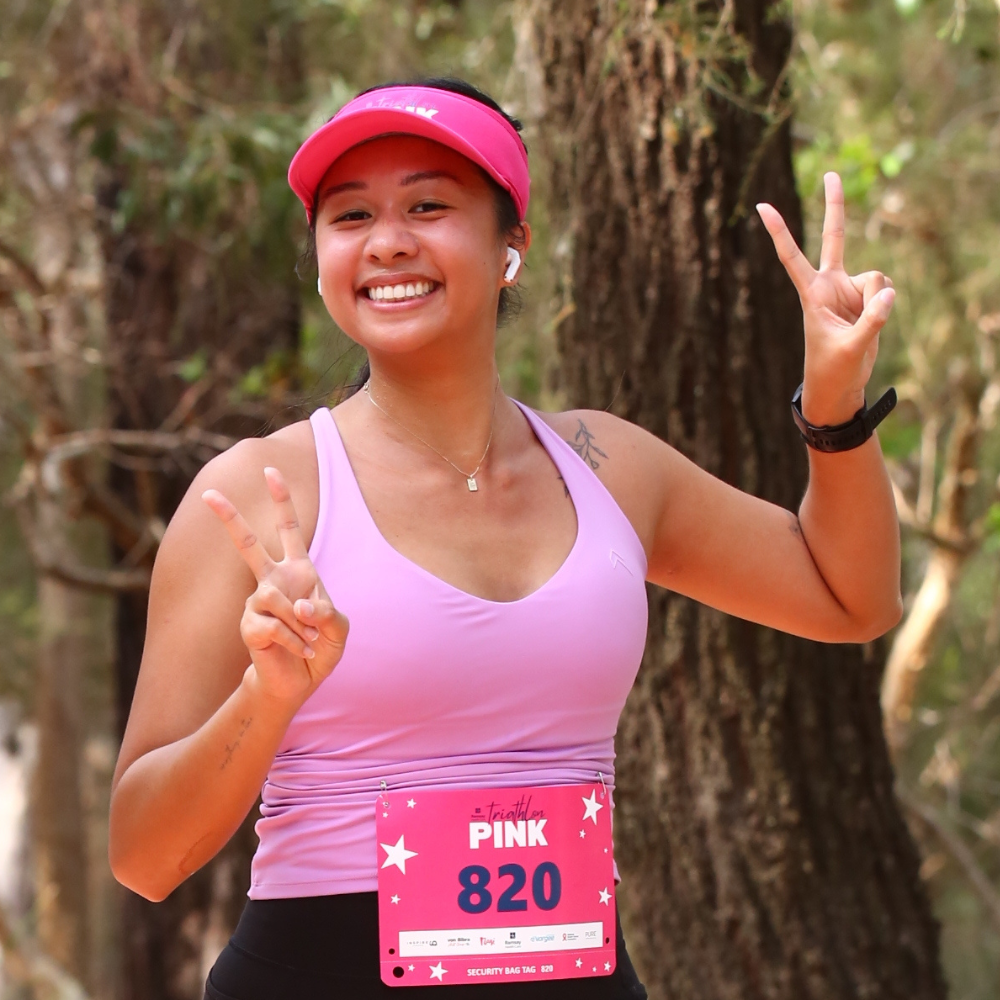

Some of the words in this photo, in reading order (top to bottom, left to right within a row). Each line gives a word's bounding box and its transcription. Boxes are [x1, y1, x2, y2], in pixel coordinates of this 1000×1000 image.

[485, 794, 546, 825] triathlon
[469, 819, 549, 849] PINK
[457, 861, 561, 914] 820
[467, 967, 503, 976] SECURITY
[504, 966, 521, 975] BAG
[521, 965, 536, 974] TAG
[540, 964, 554, 973] 820
